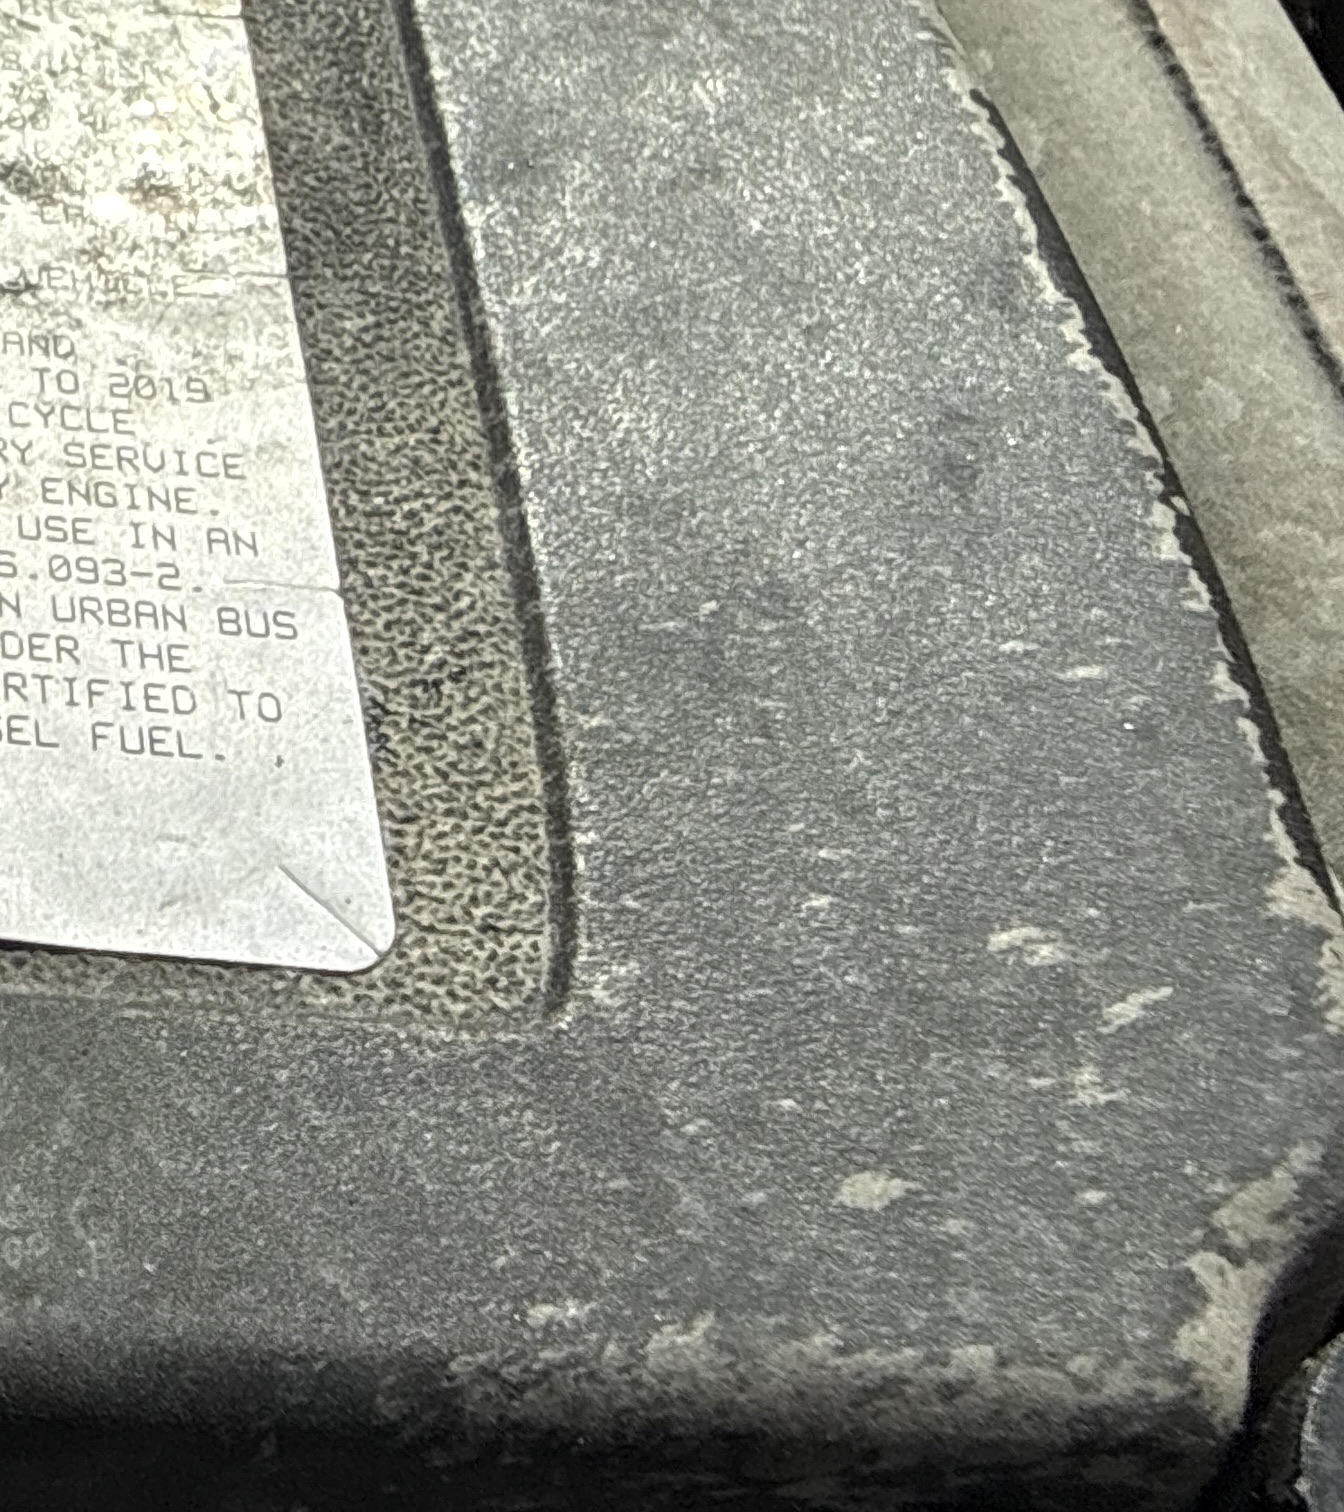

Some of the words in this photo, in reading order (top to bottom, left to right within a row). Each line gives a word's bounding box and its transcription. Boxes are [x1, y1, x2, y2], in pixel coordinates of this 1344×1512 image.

[1, 329, 76, 361] AND
[30, 366, 80, 396] TO
[106, 371, 210, 406] 2019
[7, 400, 136, 437] CYCLE
[62, 440, 247, 482] SERVICE
[40, 476, 221, 518] ENGINE.
[16, 512, 96, 547] USE
[126, 520, 177, 553] IN
[204, 526, 258, 559] AN
[51, 593, 188, 634] URBAN
[215, 605, 299, 643] BUS
[109, 638, 193, 676] THE
[226, 688, 283, 725] TO
[89, 720, 226, 764] FUEL.
